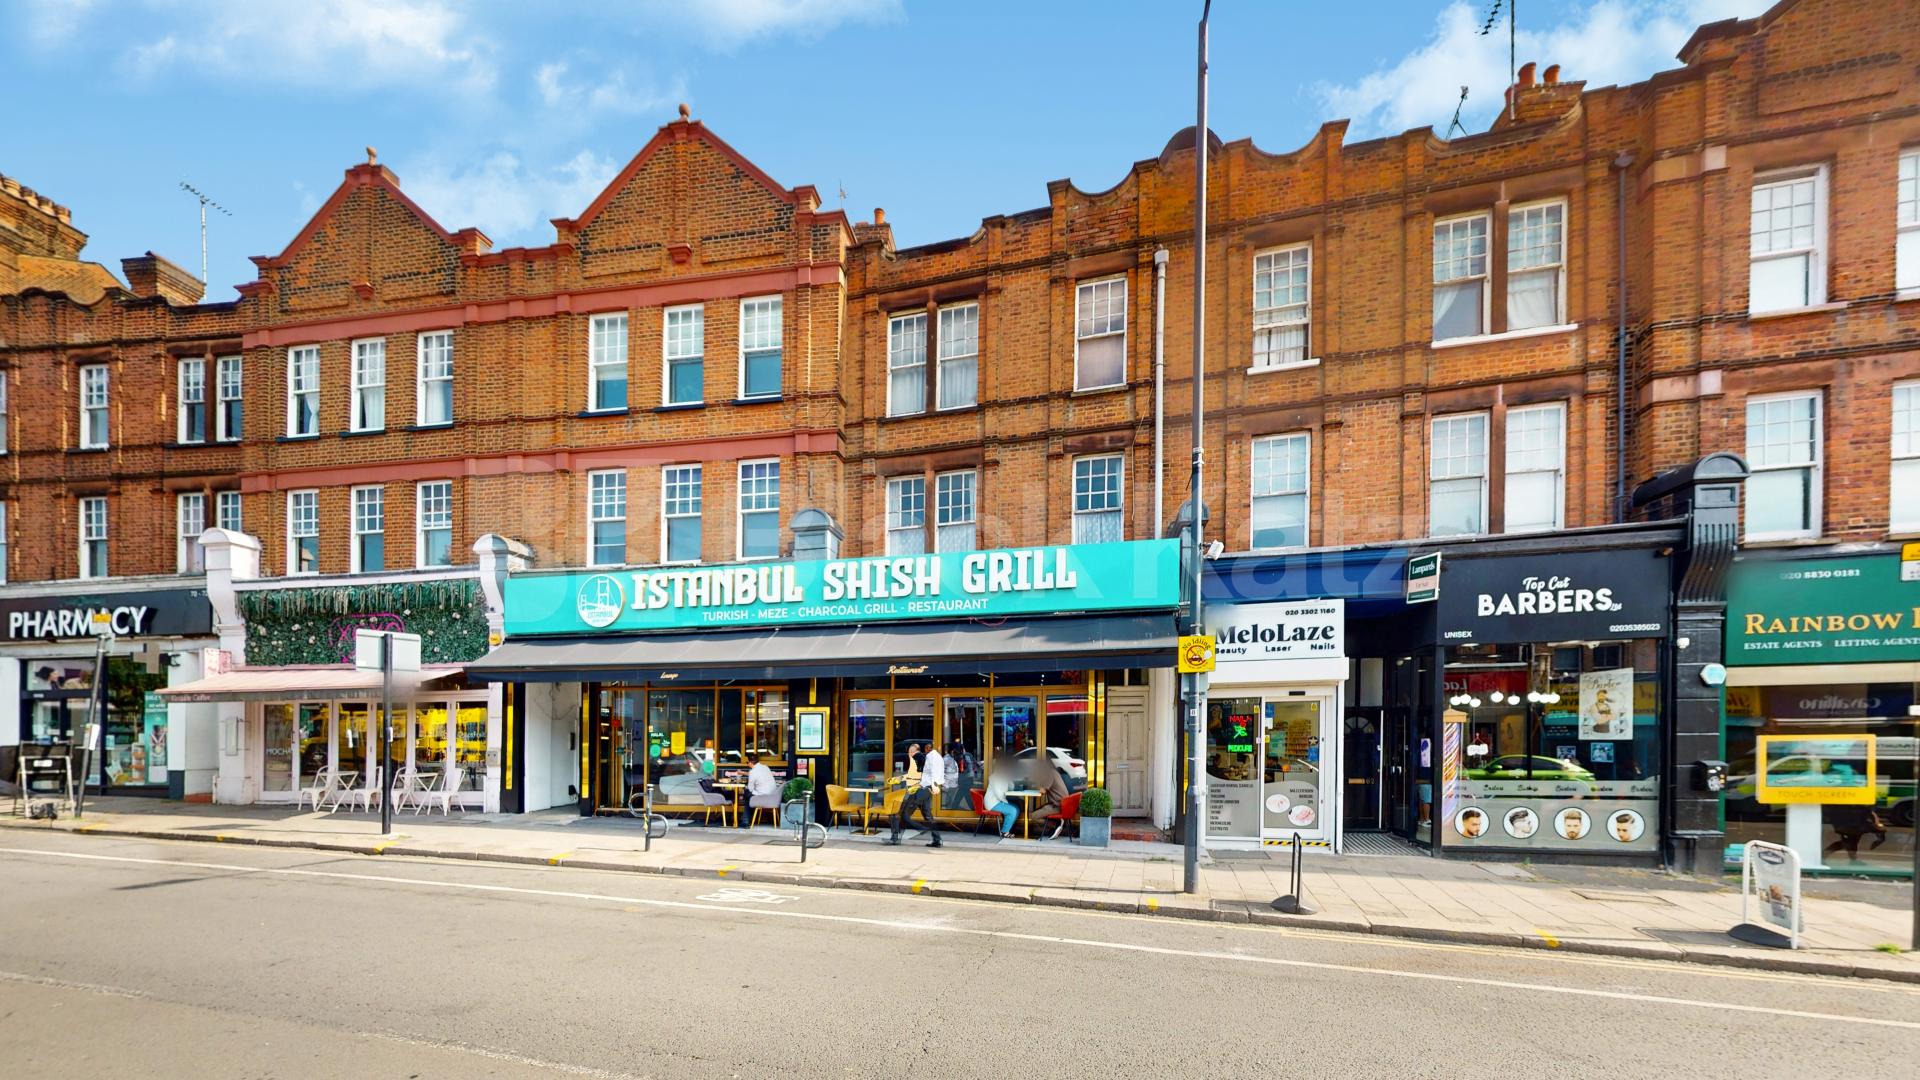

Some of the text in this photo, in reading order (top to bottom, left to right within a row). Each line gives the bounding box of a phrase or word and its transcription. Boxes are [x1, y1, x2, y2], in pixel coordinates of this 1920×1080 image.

[631, 548, 1077, 610] ISTANBUL SHISH GRILL
[1833, 569, 1860, 577] 0181
[1522, 575, 1571, 592] Top Cut
[702, 598, 988, 622] TURKISH MEZE CHARCOAL GRILL RESTAURANT
[1477, 588, 1613, 617] BARBERS
[9, 605, 148, 638] PHARMCY
[1744, 612, 1903, 635] RAINBOW
[1215, 622, 1335, 645] MeloLaze
[1444, 630, 1473, 639] UNISEX
[1182, 642, 1192, 651] No
[1265, 645, 1292, 653] Laser
[1310, 643, 1336, 651] Nails
[1743, 641, 1780, 650] ESTATE
[1782, 639, 1823, 649] AGENTS
[1833, 638, 1880, 648] LETTING
